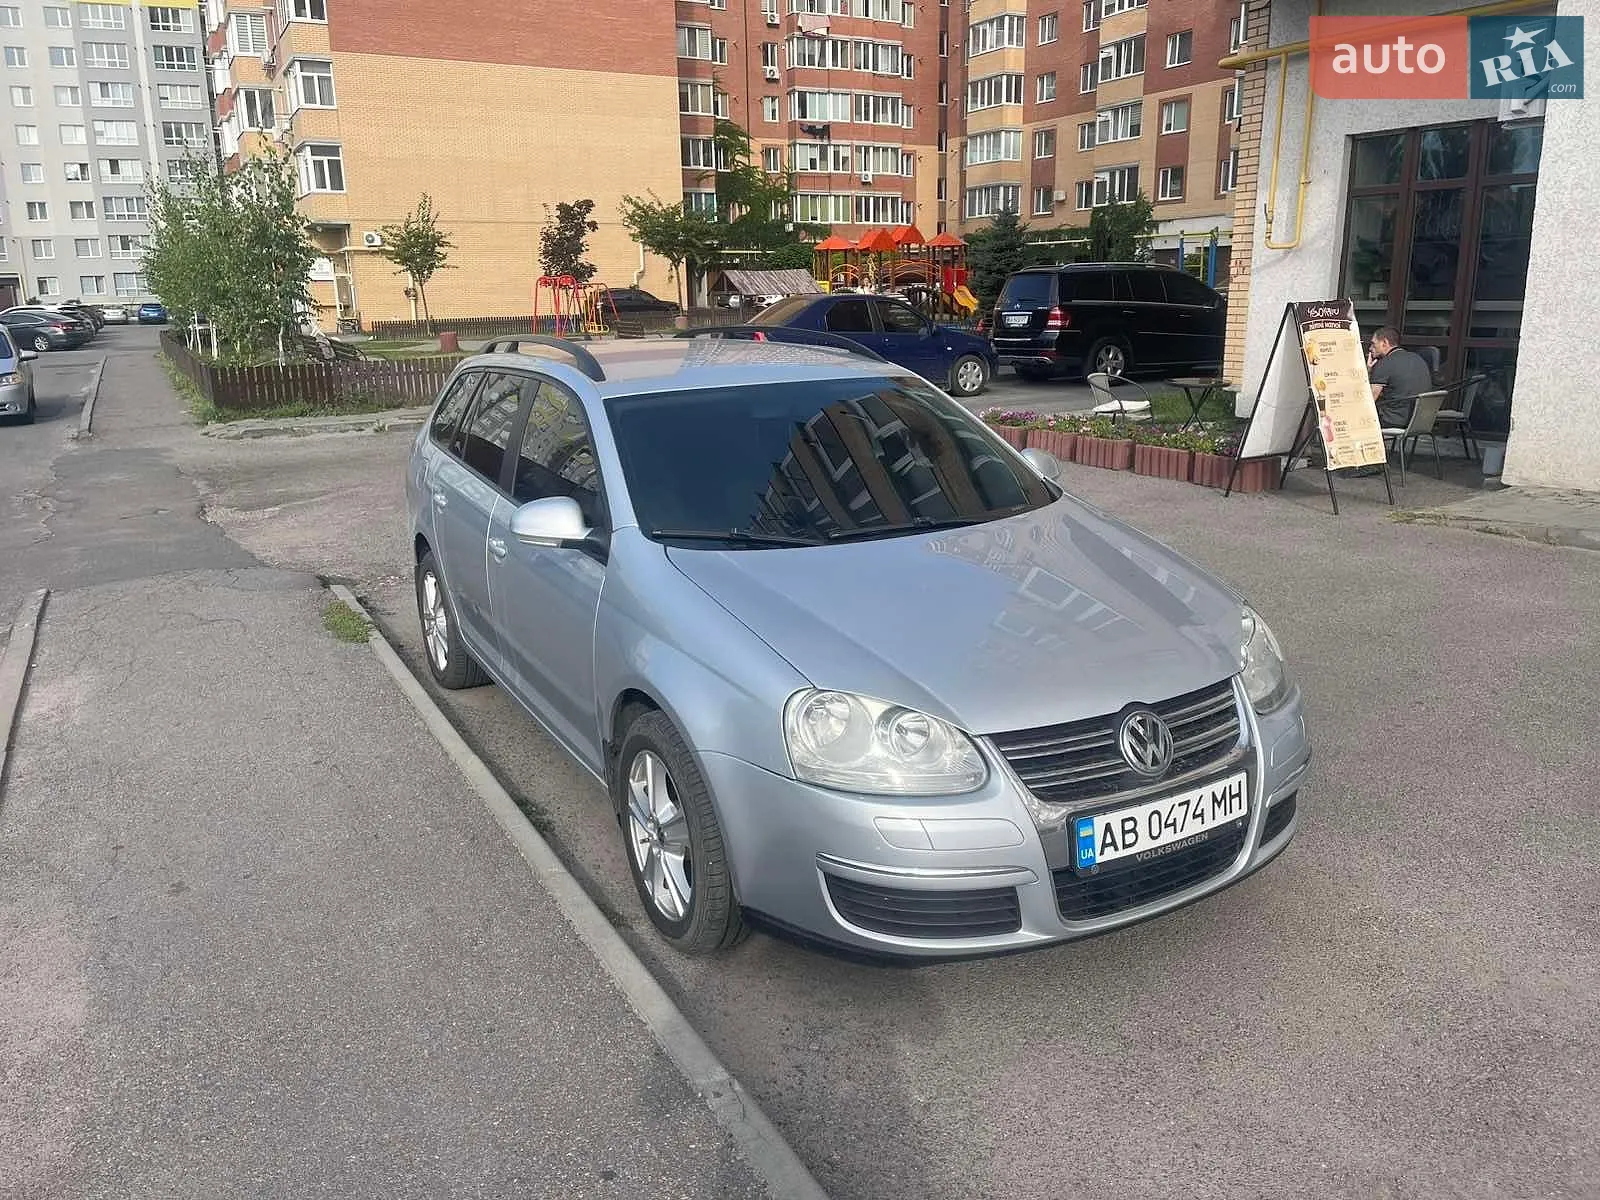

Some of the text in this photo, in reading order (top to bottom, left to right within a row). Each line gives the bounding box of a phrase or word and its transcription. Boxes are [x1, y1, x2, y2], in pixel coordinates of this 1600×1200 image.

[1099, 781, 1242, 856] AB 0474 MH
[1080, 849, 1095, 860] UA
[1135, 832, 1209, 862] VOLKSWAGEN
